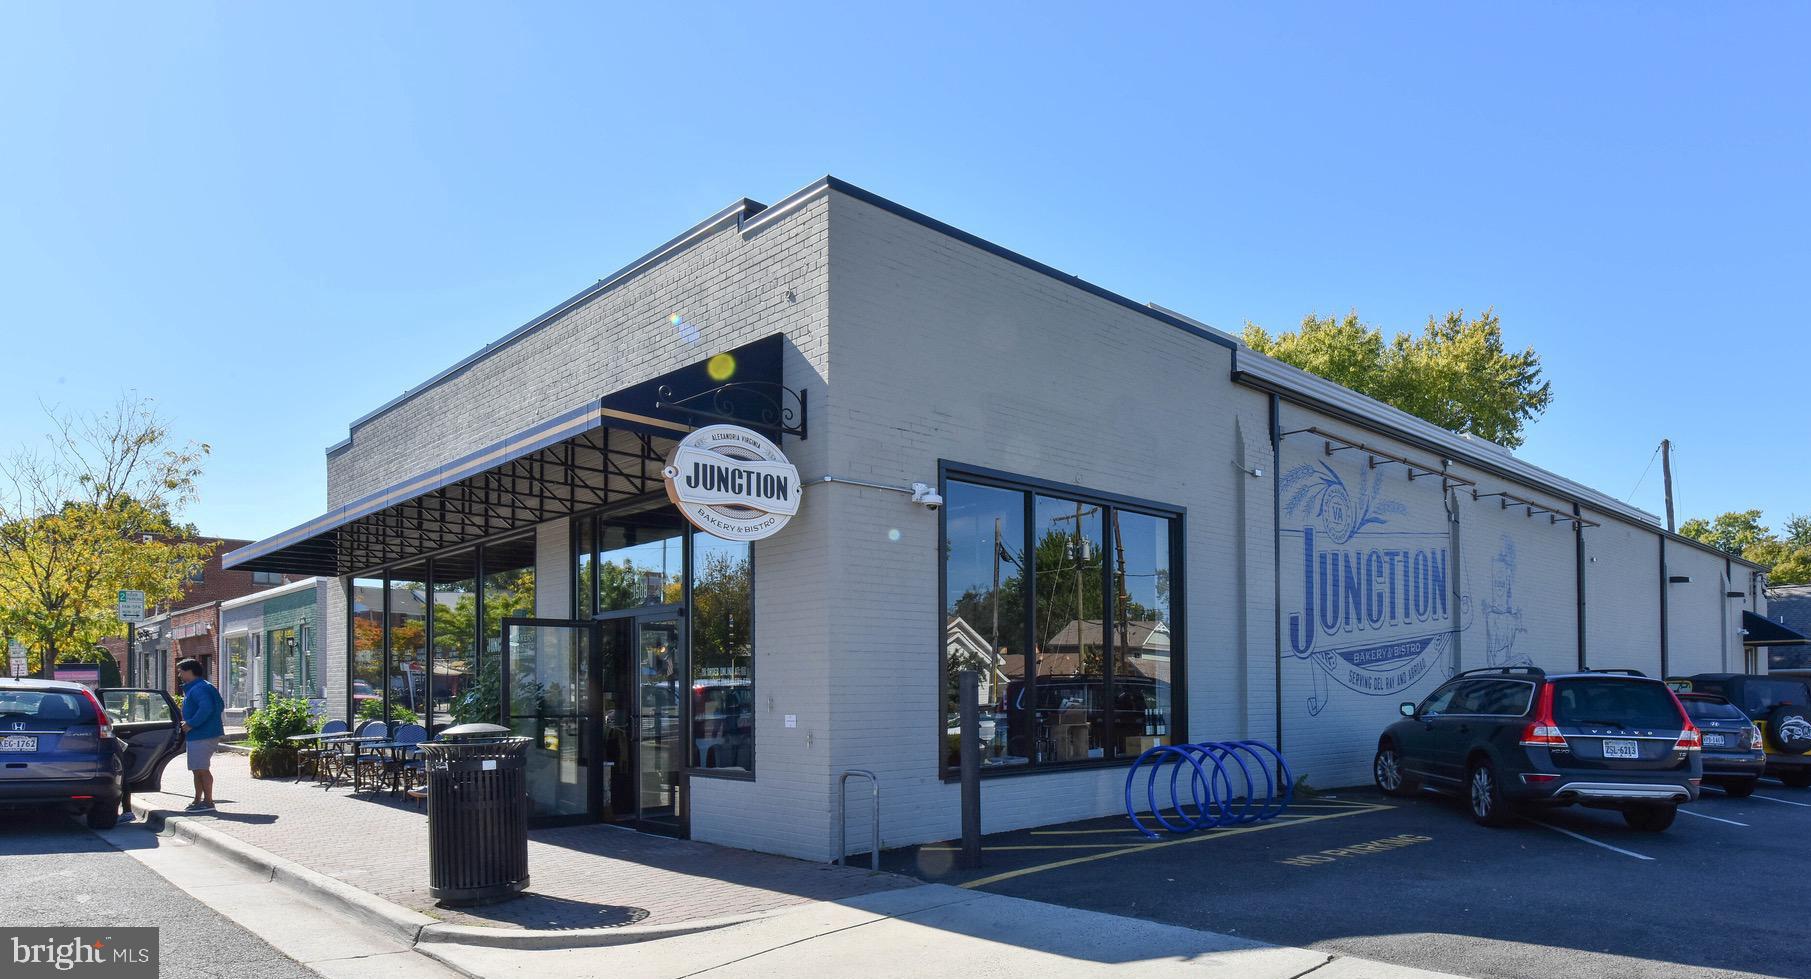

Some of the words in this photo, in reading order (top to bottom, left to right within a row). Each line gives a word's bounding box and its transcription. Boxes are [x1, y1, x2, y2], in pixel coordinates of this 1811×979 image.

[711, 433, 740, 441] ALEXANDRIA
[741, 435, 761, 449] VIRGINIA
[685, 462, 788, 501] JUNCTION
[697, 508, 736, 531] BAKERY
[744, 517, 776, 533] BISTRO
[1332, 505, 1343, 522] VA
[1289, 526, 1449, 659] JUNCTION
[1353, 649, 1387, 663] BAKERY
[1394, 642, 1421, 657] BISTRO
[1348, 670, 1372, 690] SERVING
[1373, 677, 1384, 690] DEL
[1385, 677, 1395, 690] RAY
[1397, 672, 1407, 686] AND
[1408, 658, 1427, 680] ABROAD
[1273, 855, 1336, 867] NO
[1319, 834, 1433, 858] PARKING
